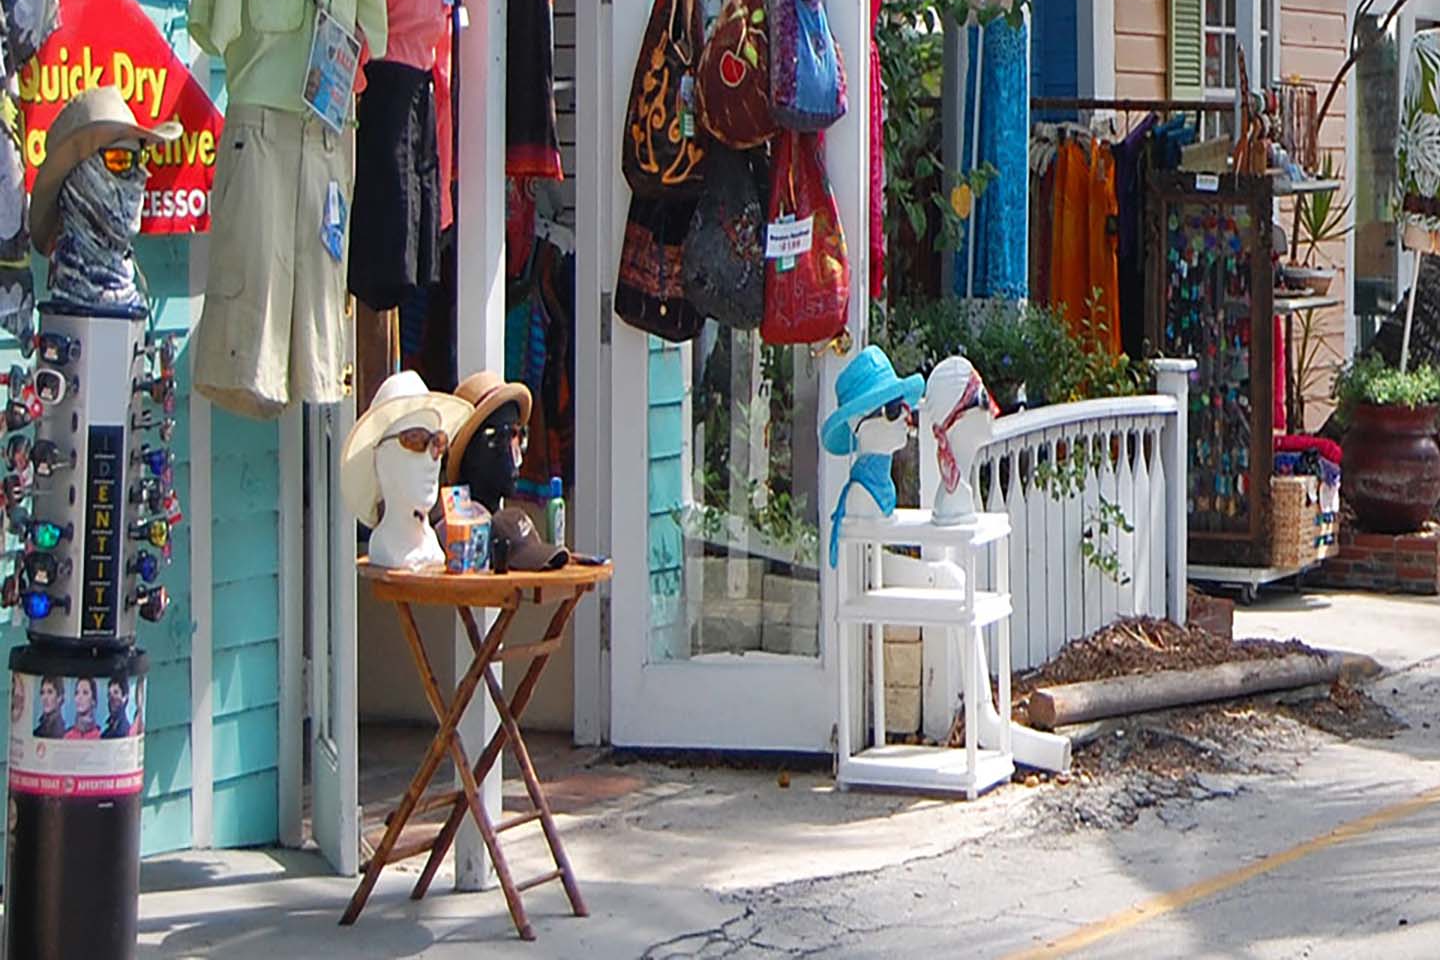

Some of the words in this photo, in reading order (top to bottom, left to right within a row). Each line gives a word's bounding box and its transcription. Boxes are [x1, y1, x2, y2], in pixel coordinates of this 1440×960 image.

[18, 46, 104, 103] Quick
[112, 51, 168, 118] Dry
[91, 434, 112, 630] IDENTITY
